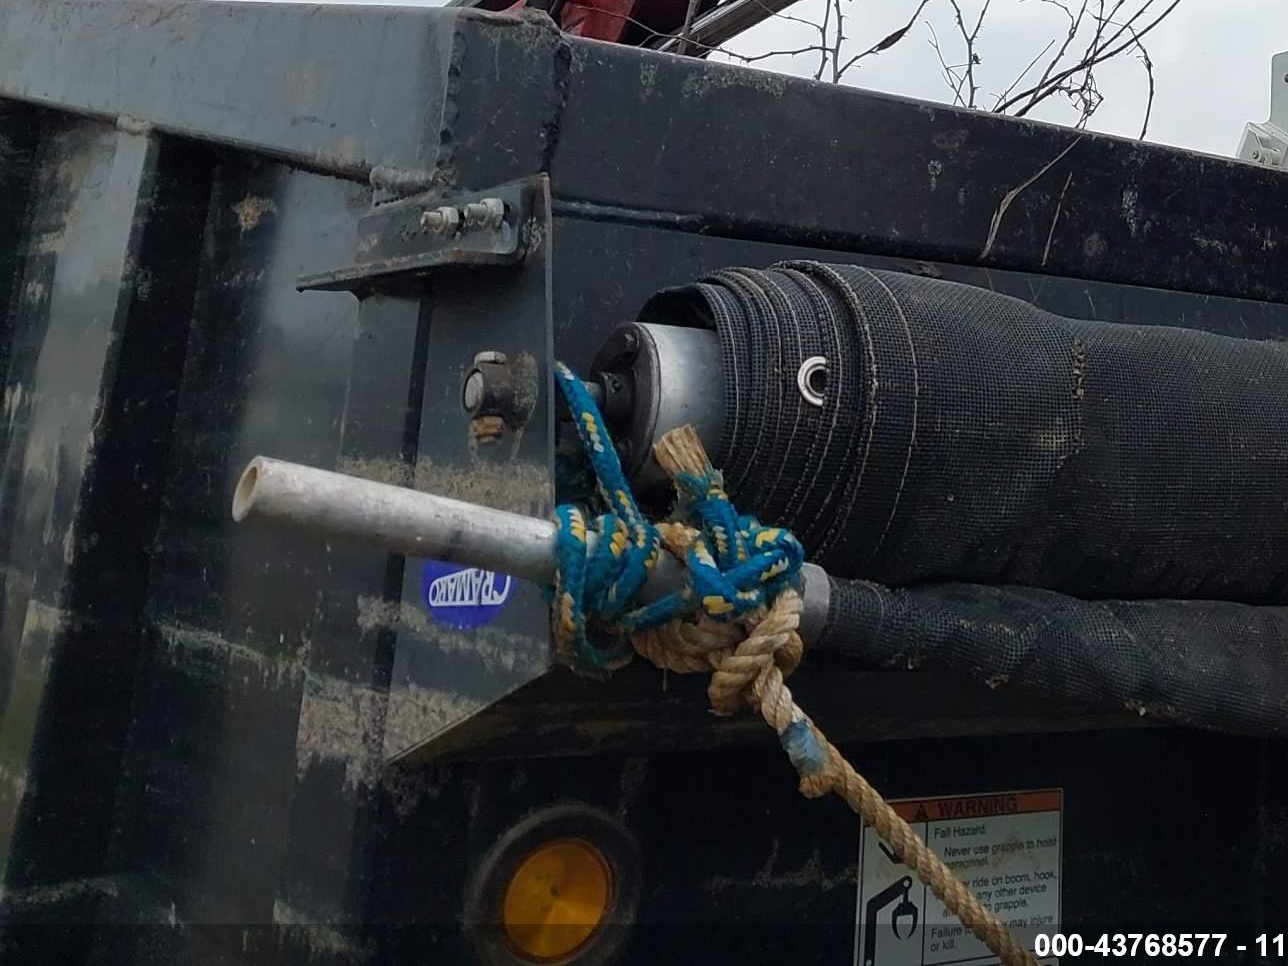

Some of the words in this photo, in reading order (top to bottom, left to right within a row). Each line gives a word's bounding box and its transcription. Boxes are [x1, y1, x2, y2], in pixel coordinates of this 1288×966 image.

[937, 795, 1018, 817] WARNING
[934, 826, 951, 839] Fall
[944, 845, 971, 858] Never
[974, 844, 989, 854] use
[972, 876, 989, 887] ride
[992, 877, 1002, 886] on
[976, 890, 993, 901] any
[994, 887, 1017, 900] other
[1018, 883, 1047, 896] device
[1009, 918, 1028, 930] may
[931, 926, 962, 939] Failure
[930, 942, 940, 952] or
